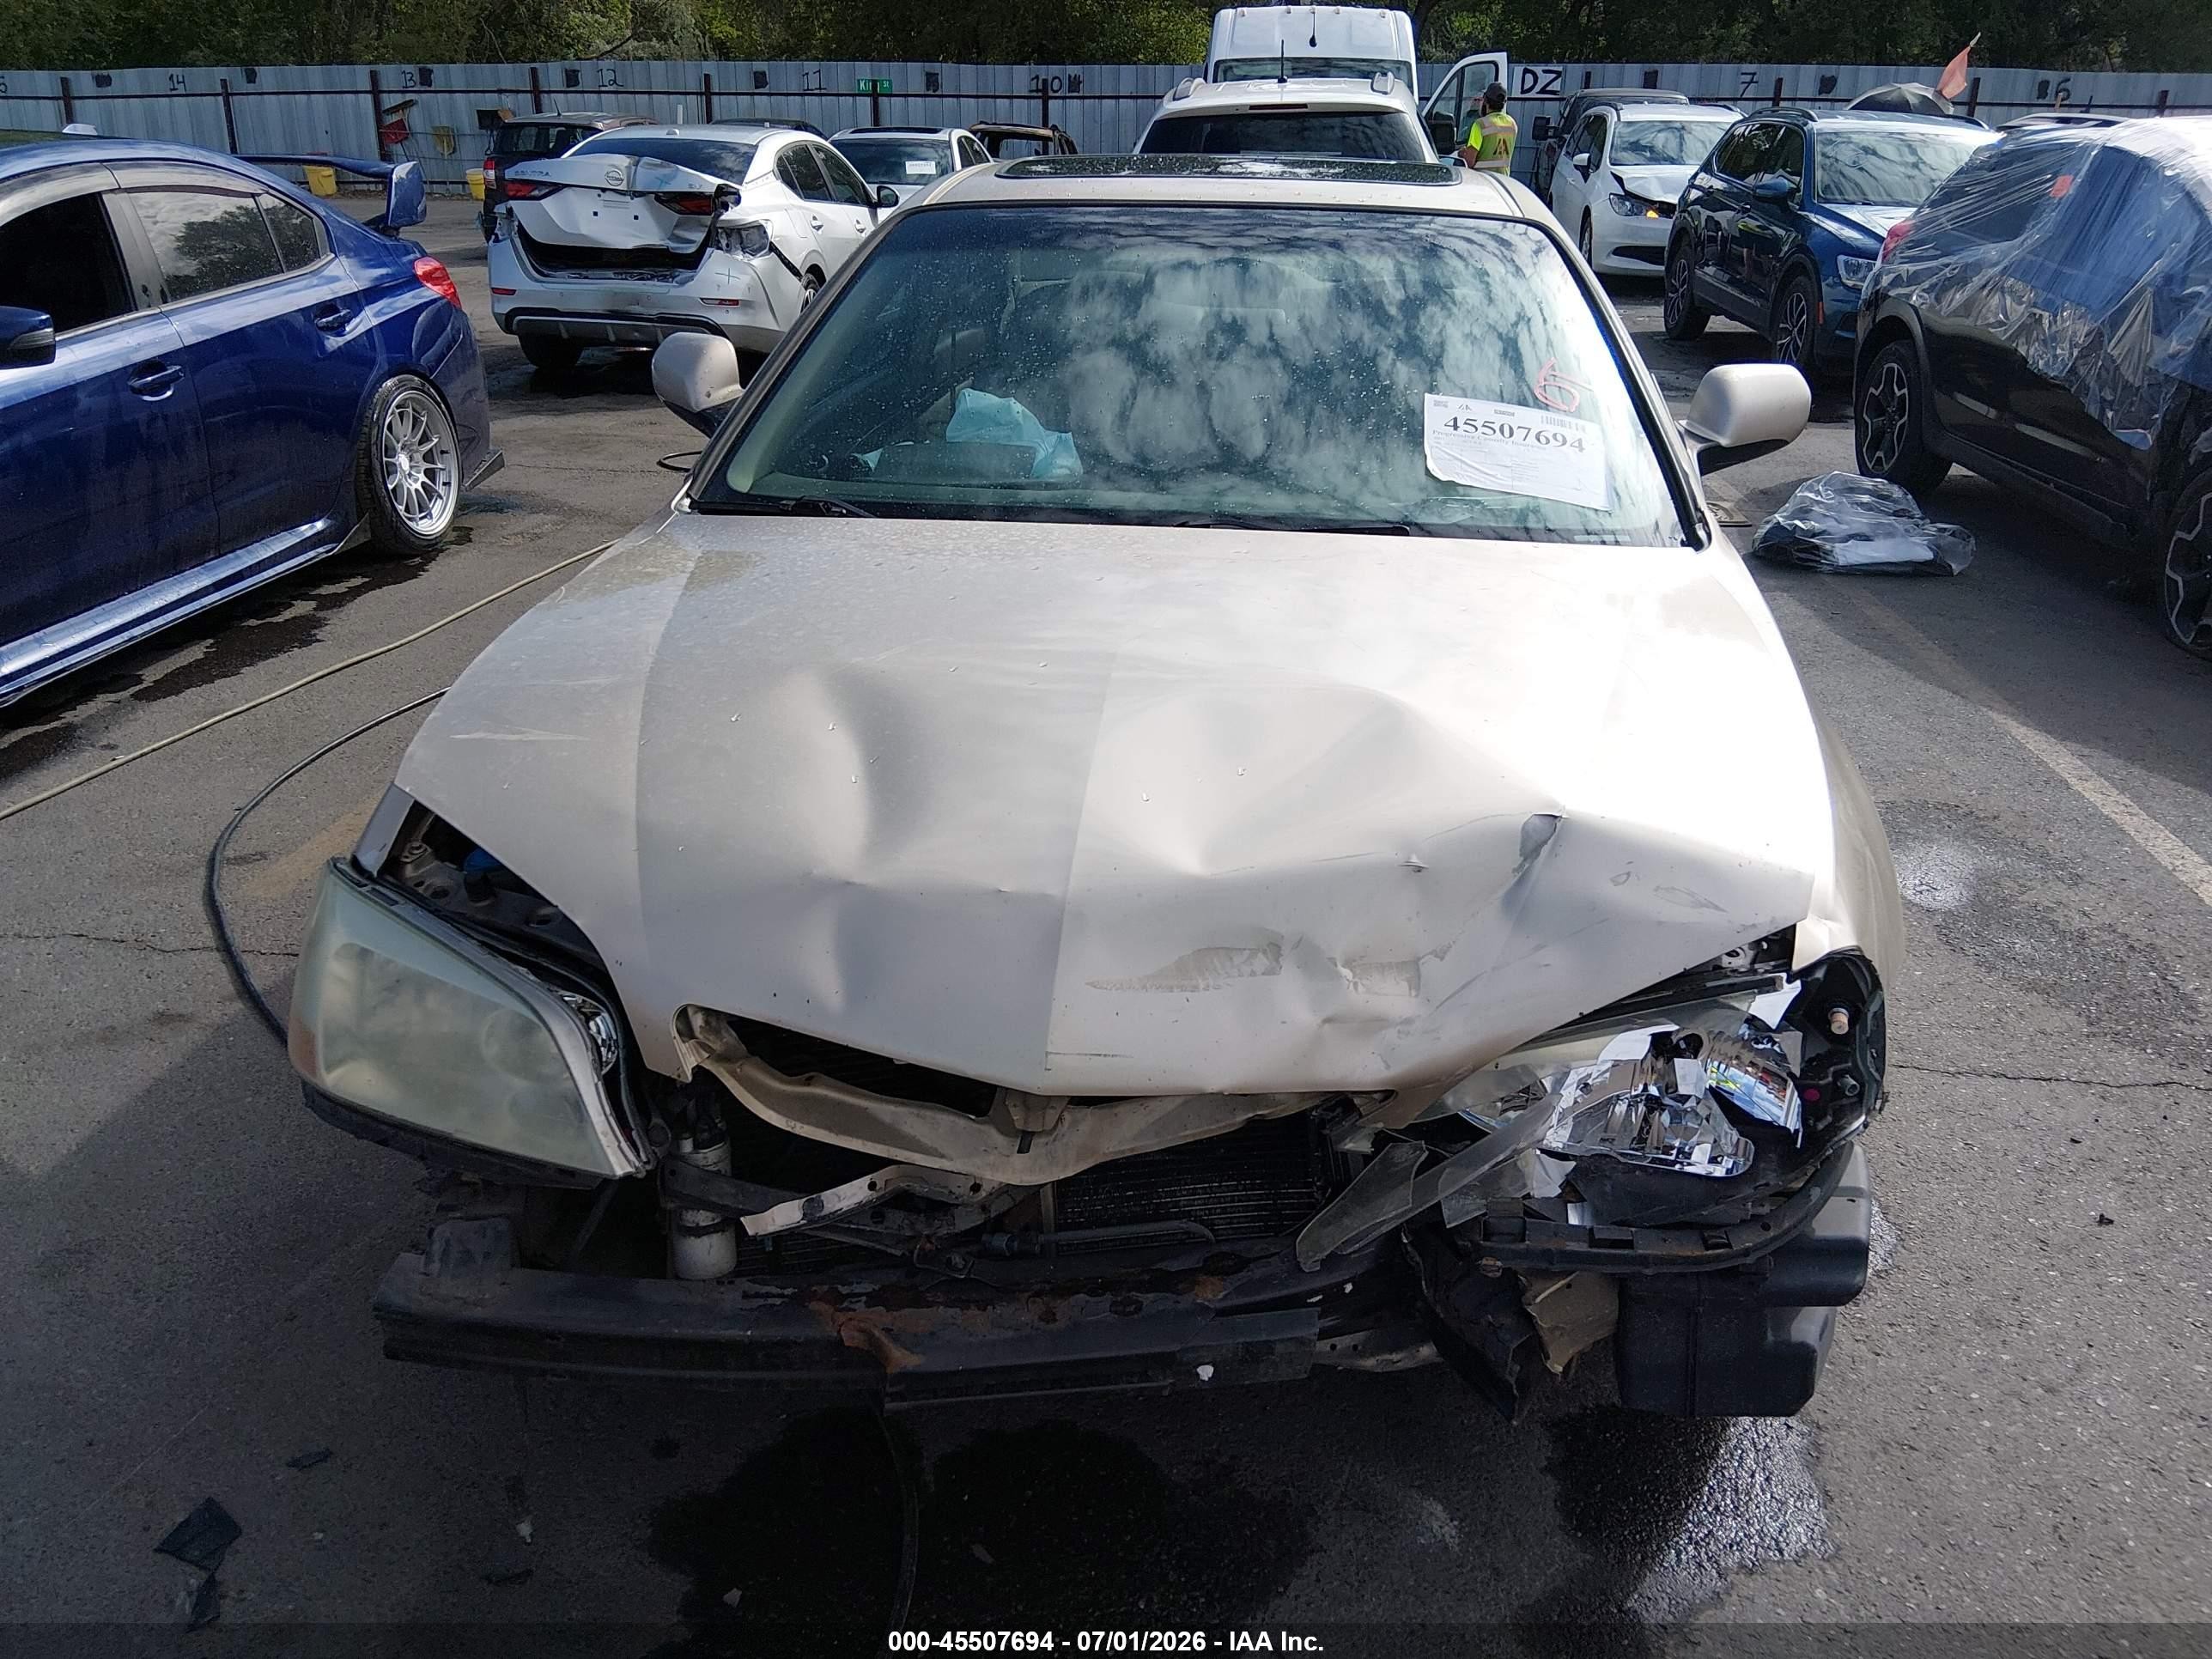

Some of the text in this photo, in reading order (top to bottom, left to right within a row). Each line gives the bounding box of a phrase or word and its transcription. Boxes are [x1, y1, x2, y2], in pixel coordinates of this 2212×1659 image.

[168, 73, 187, 92] 14
[401, 70, 416, 88] 13
[596, 68, 624, 88] 12
[801, 69, 827, 91] 11
[1520, 67, 1563, 96] DZ
[1740, 72, 1759, 97] 7
[2055, 77, 2071, 101] 6
[1443, 416, 1587, 453] 45507694
